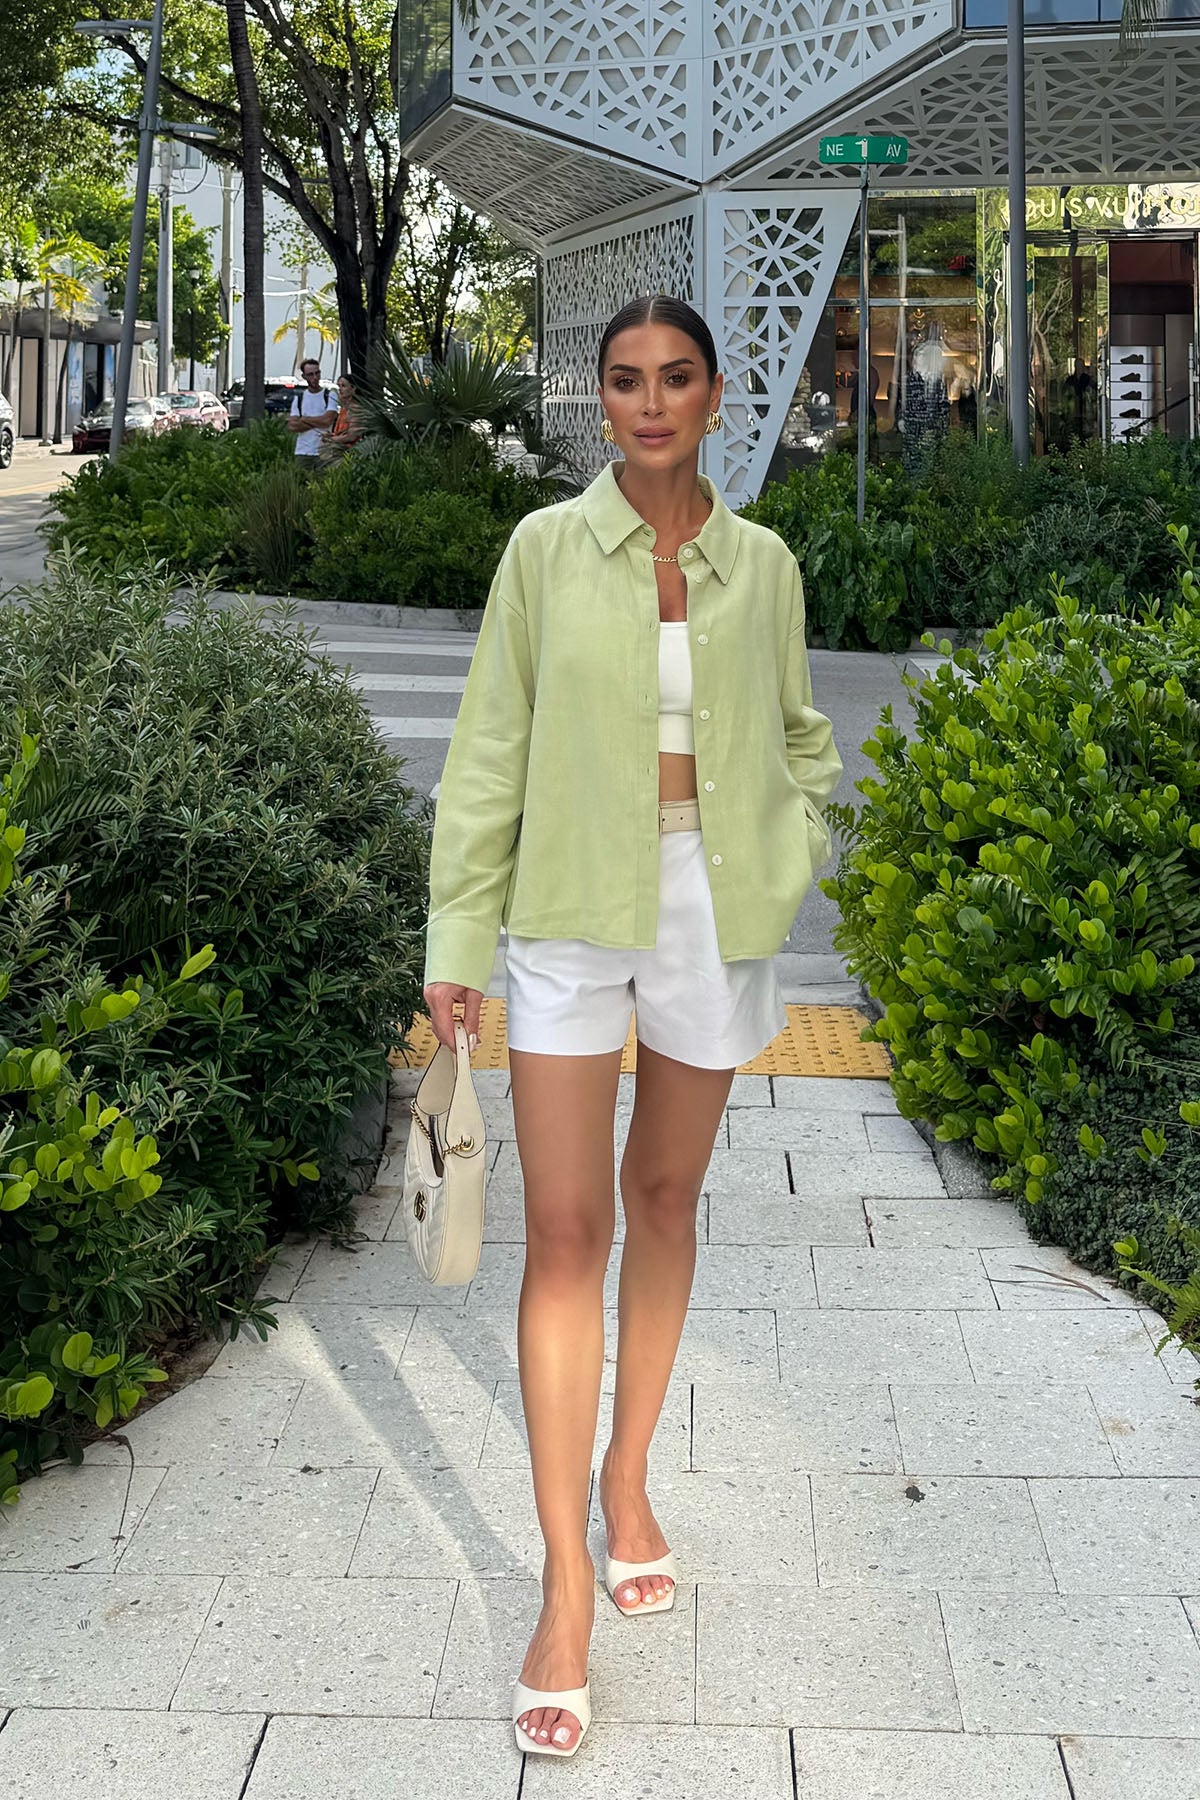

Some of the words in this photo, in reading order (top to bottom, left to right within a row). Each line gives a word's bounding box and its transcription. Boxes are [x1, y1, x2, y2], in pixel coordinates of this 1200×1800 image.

[826, 144, 844, 156] NE
[855, 138, 868, 159] 1
[886, 143, 902, 157] AV
[1093, 196, 1200, 217] VUITTO
